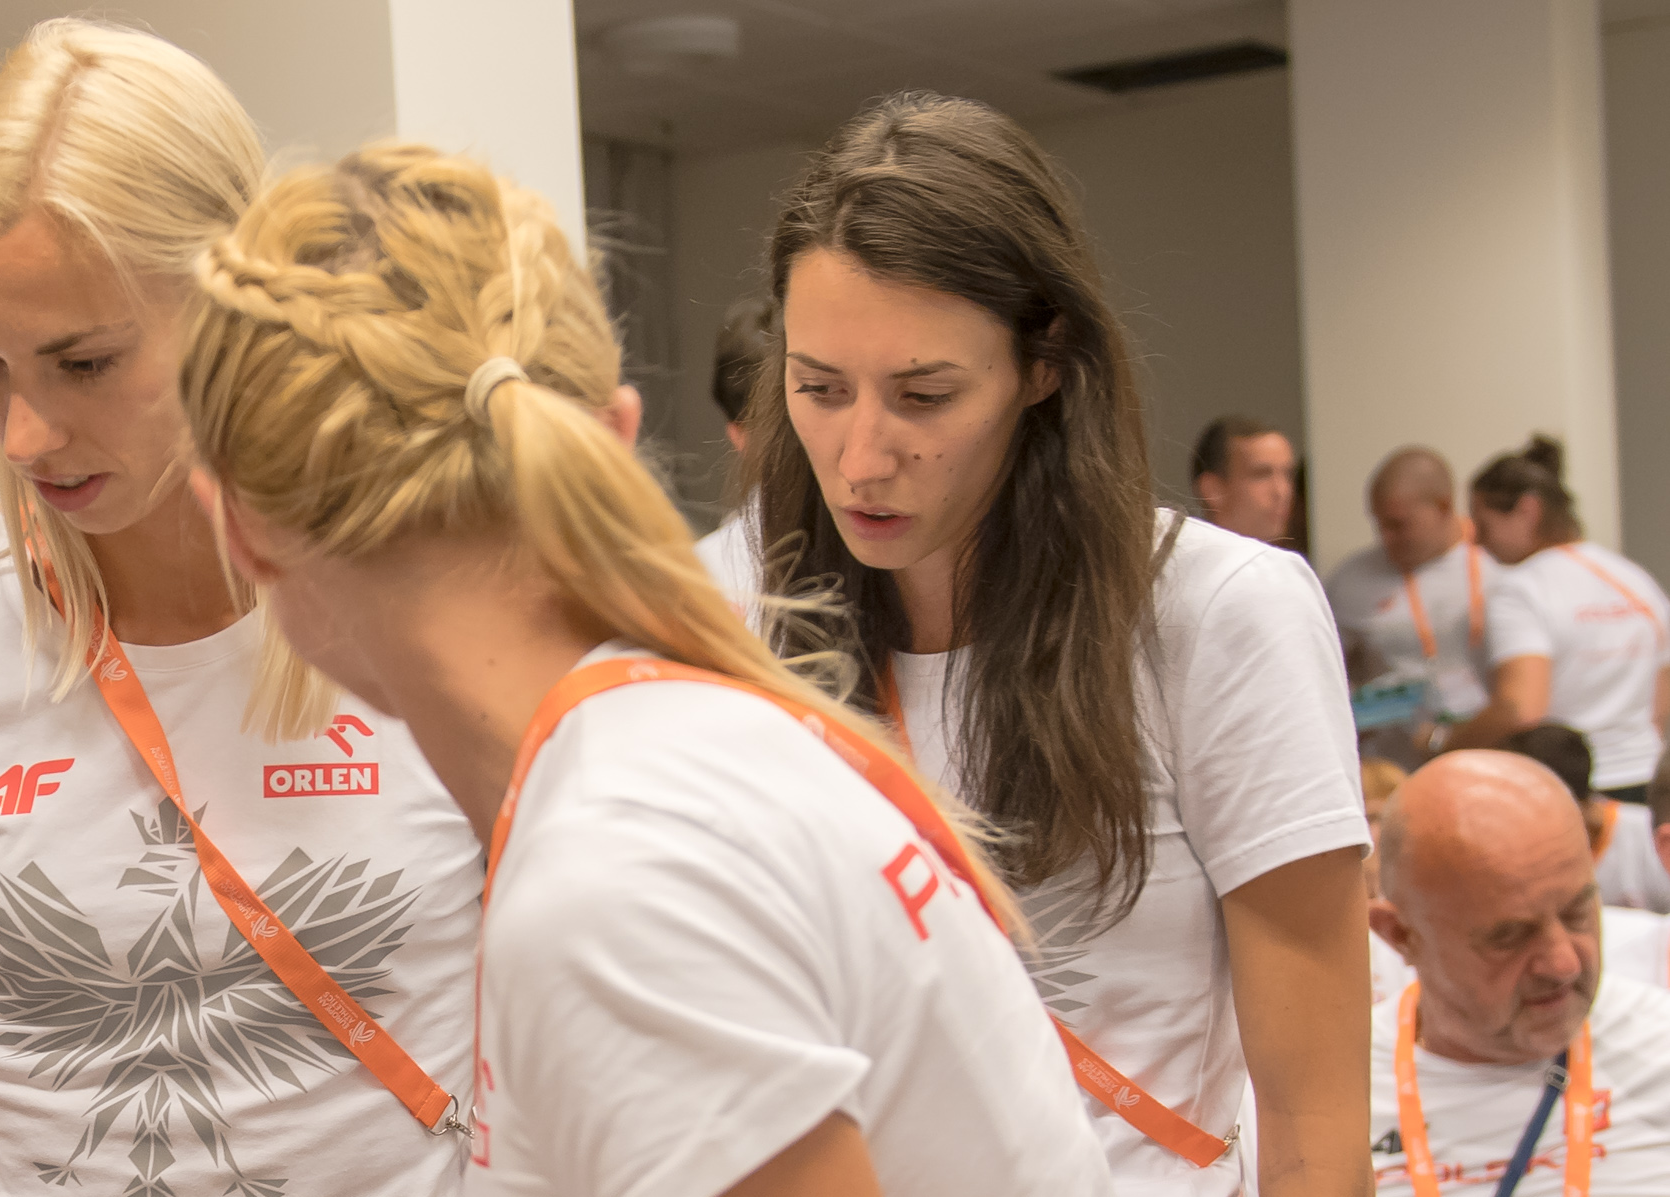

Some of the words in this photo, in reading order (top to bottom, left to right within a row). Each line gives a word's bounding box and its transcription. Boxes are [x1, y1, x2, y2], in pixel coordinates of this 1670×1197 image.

[269, 767, 373, 794] ORLEN
[881, 842, 962, 941] P
[317, 996, 350, 1029] EUROPEAN
[323, 991, 356, 1024] ATHLETICS
